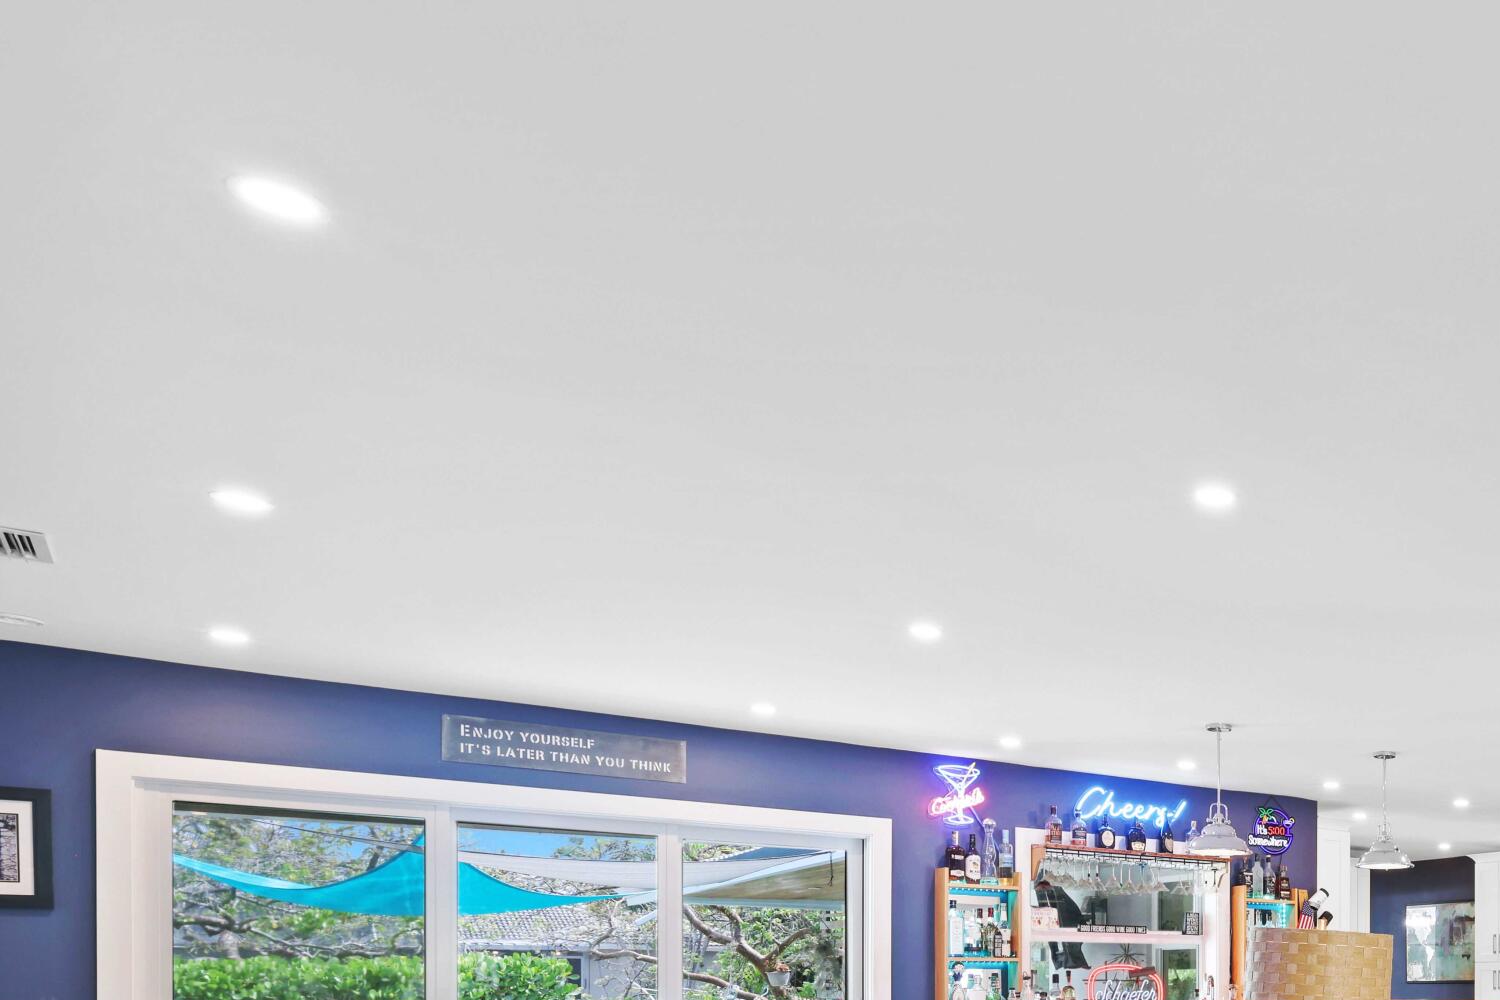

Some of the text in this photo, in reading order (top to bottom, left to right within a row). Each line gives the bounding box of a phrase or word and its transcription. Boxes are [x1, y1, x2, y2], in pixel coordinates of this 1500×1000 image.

[460, 724, 595, 750] ENJOY YOURSELF
[460, 742, 672, 773] IT'S LATER THAN YOU THINK
[1268, 826, 1285, 836] 5:00
[1248, 835, 1288, 847] Somewhere
